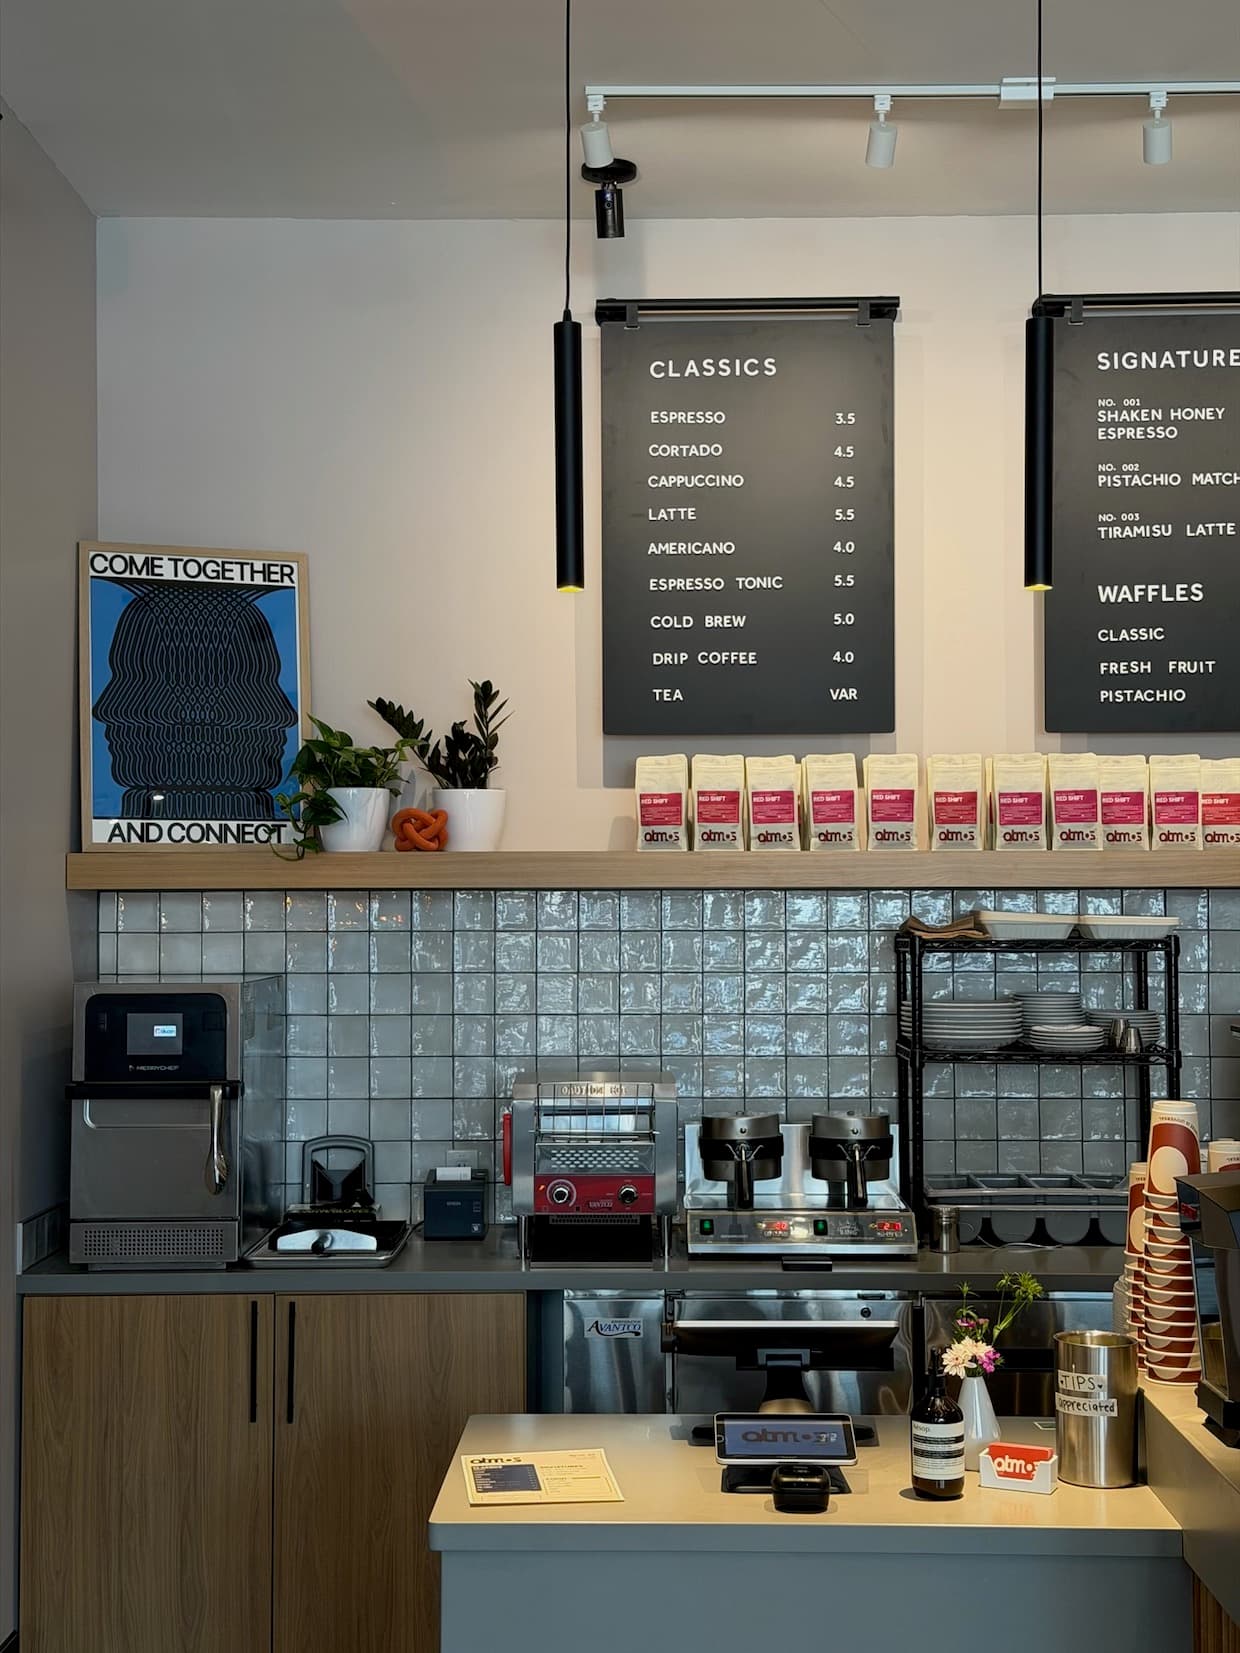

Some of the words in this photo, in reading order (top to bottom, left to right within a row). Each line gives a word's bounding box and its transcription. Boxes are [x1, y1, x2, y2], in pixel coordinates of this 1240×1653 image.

[649, 357, 777, 379] CLASSICS
[1097, 398, 1117, 407] NO.
[1123, 398, 1141, 407] 001
[650, 410, 726, 424] ESPRESSO
[835, 412, 856, 425] 3.5
[1097, 408, 1162, 423] SHAKEN
[1170, 407, 1225, 421] HONEY
[1097, 426, 1178, 440] ESPRESSO
[648, 443, 723, 457] CORTADO
[833, 445, 854, 458] 4.5
[1098, 463, 1117, 472] NO.
[1121, 463, 1140, 472] 002
[647, 474, 745, 488] CAPPUCCINO
[833, 475, 855, 488] 4.5
[1097, 473, 1182, 487] PISTACHIO
[648, 507, 697, 521] LATTE
[834, 508, 855, 521] 5.5
[1098, 513, 1117, 522] NO.
[1120, 512, 1140, 522] 003
[1097, 523, 1172, 539] TIRAMISU
[1186, 522, 1236, 537] LATTE
[647, 541, 736, 555] AMERICANO
[833, 541, 855, 553] 4.0
[90, 553, 164, 577] COME
[168, 556, 295, 584] TOGETHER
[649, 577, 725, 591] ESPRESSO
[735, 575, 783, 590] TONIC
[834, 574, 855, 587] 5.5
[1097, 583, 1204, 603] WAFFLES
[650, 615, 694, 629] COLD
[704, 615, 747, 628] BREW
[833, 612, 855, 625] 5.0
[1097, 627, 1165, 642] CLASSIC
[652, 652, 689, 665] DRIP
[697, 651, 757, 665] COFFEE
[832, 650, 855, 663] 4.0
[1100, 660, 1152, 675] FRESH
[1168, 660, 1216, 674] FRUIT
[652, 688, 684, 701] TEA
[829, 687, 858, 701] VAR
[1100, 689, 1186, 703] PISTACHIO
[107, 824, 163, 844] AND
[167, 823, 287, 844] CONNECT
[1063, 1374, 1096, 1391] TIPS
[1058, 1399, 1115, 1413] appreciated
